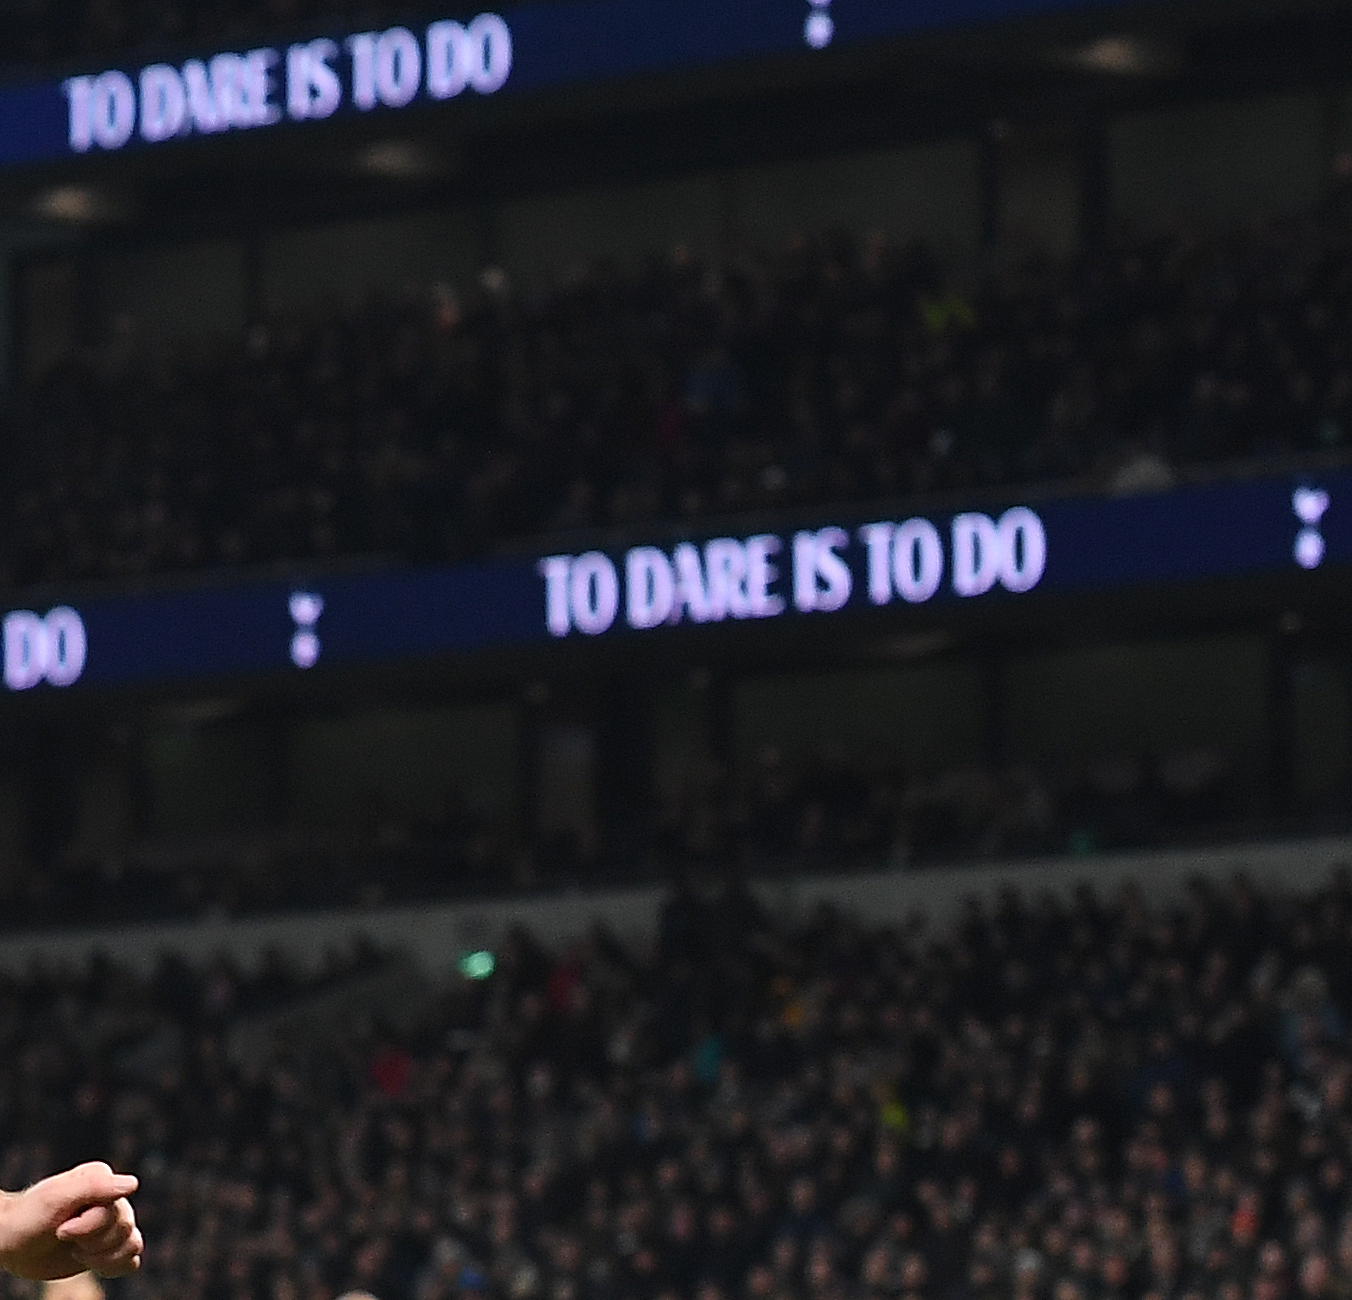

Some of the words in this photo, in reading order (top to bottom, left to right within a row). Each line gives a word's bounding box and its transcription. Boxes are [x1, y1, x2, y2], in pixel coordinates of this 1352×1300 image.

[61, 69, 136, 153] TO
[138, 46, 281, 142] DARE
[286, 37, 341, 120] IS
[345, 26, 421, 110] TO
[426, 12, 513, 99] DO
[537, 551, 618, 637] TO
[624, 533, 784, 629] DARE
[793, 526, 852, 612] IS
[858, 517, 943, 605] TO
[952, 506, 1047, 597] DO
[2, 605, 87, 690] DO
